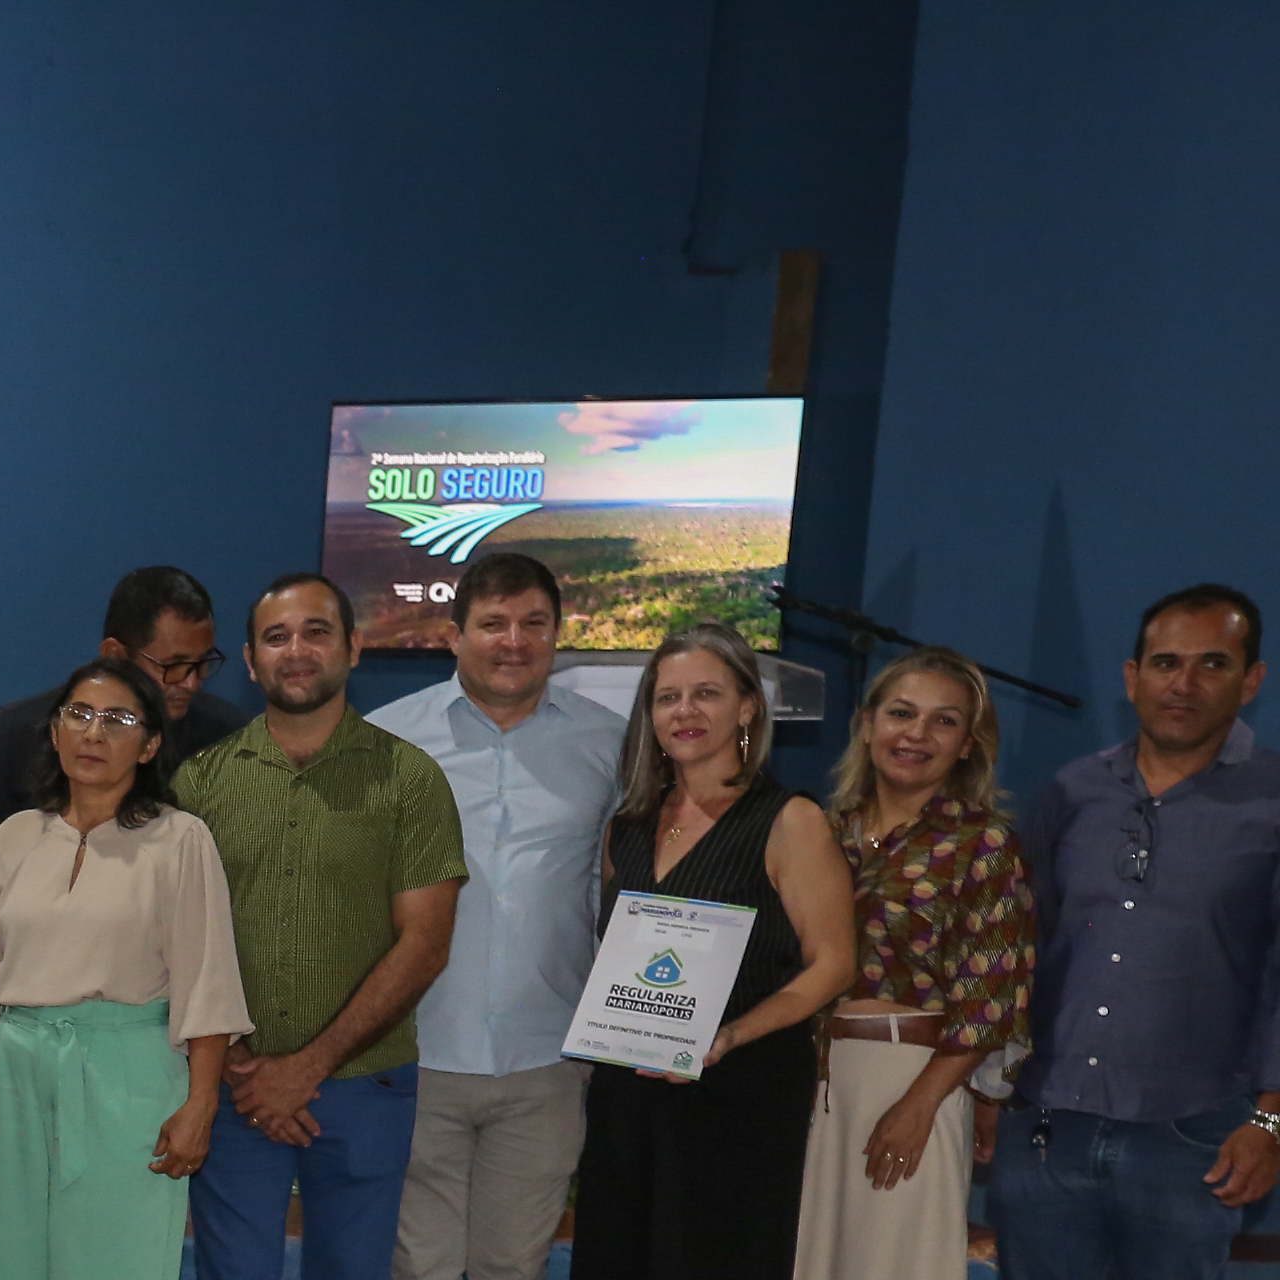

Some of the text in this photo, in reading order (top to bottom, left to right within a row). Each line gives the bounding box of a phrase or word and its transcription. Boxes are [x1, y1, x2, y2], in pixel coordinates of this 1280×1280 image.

[383, 452, 413, 465] Semana
[414, 452, 446, 465] Nacional
[447, 452, 457, 465] de
[368, 467, 545, 500] SOLO SEGURO
[609, 984, 697, 1008] REGULARIZA
[606, 997, 692, 1020] MARIANÓPOLIS
[587, 1021, 608, 1029] TÍTULO
[609, 1024, 643, 1036] DEFINITIVO
[653, 1032, 697, 1046] PROPRIEDADE
